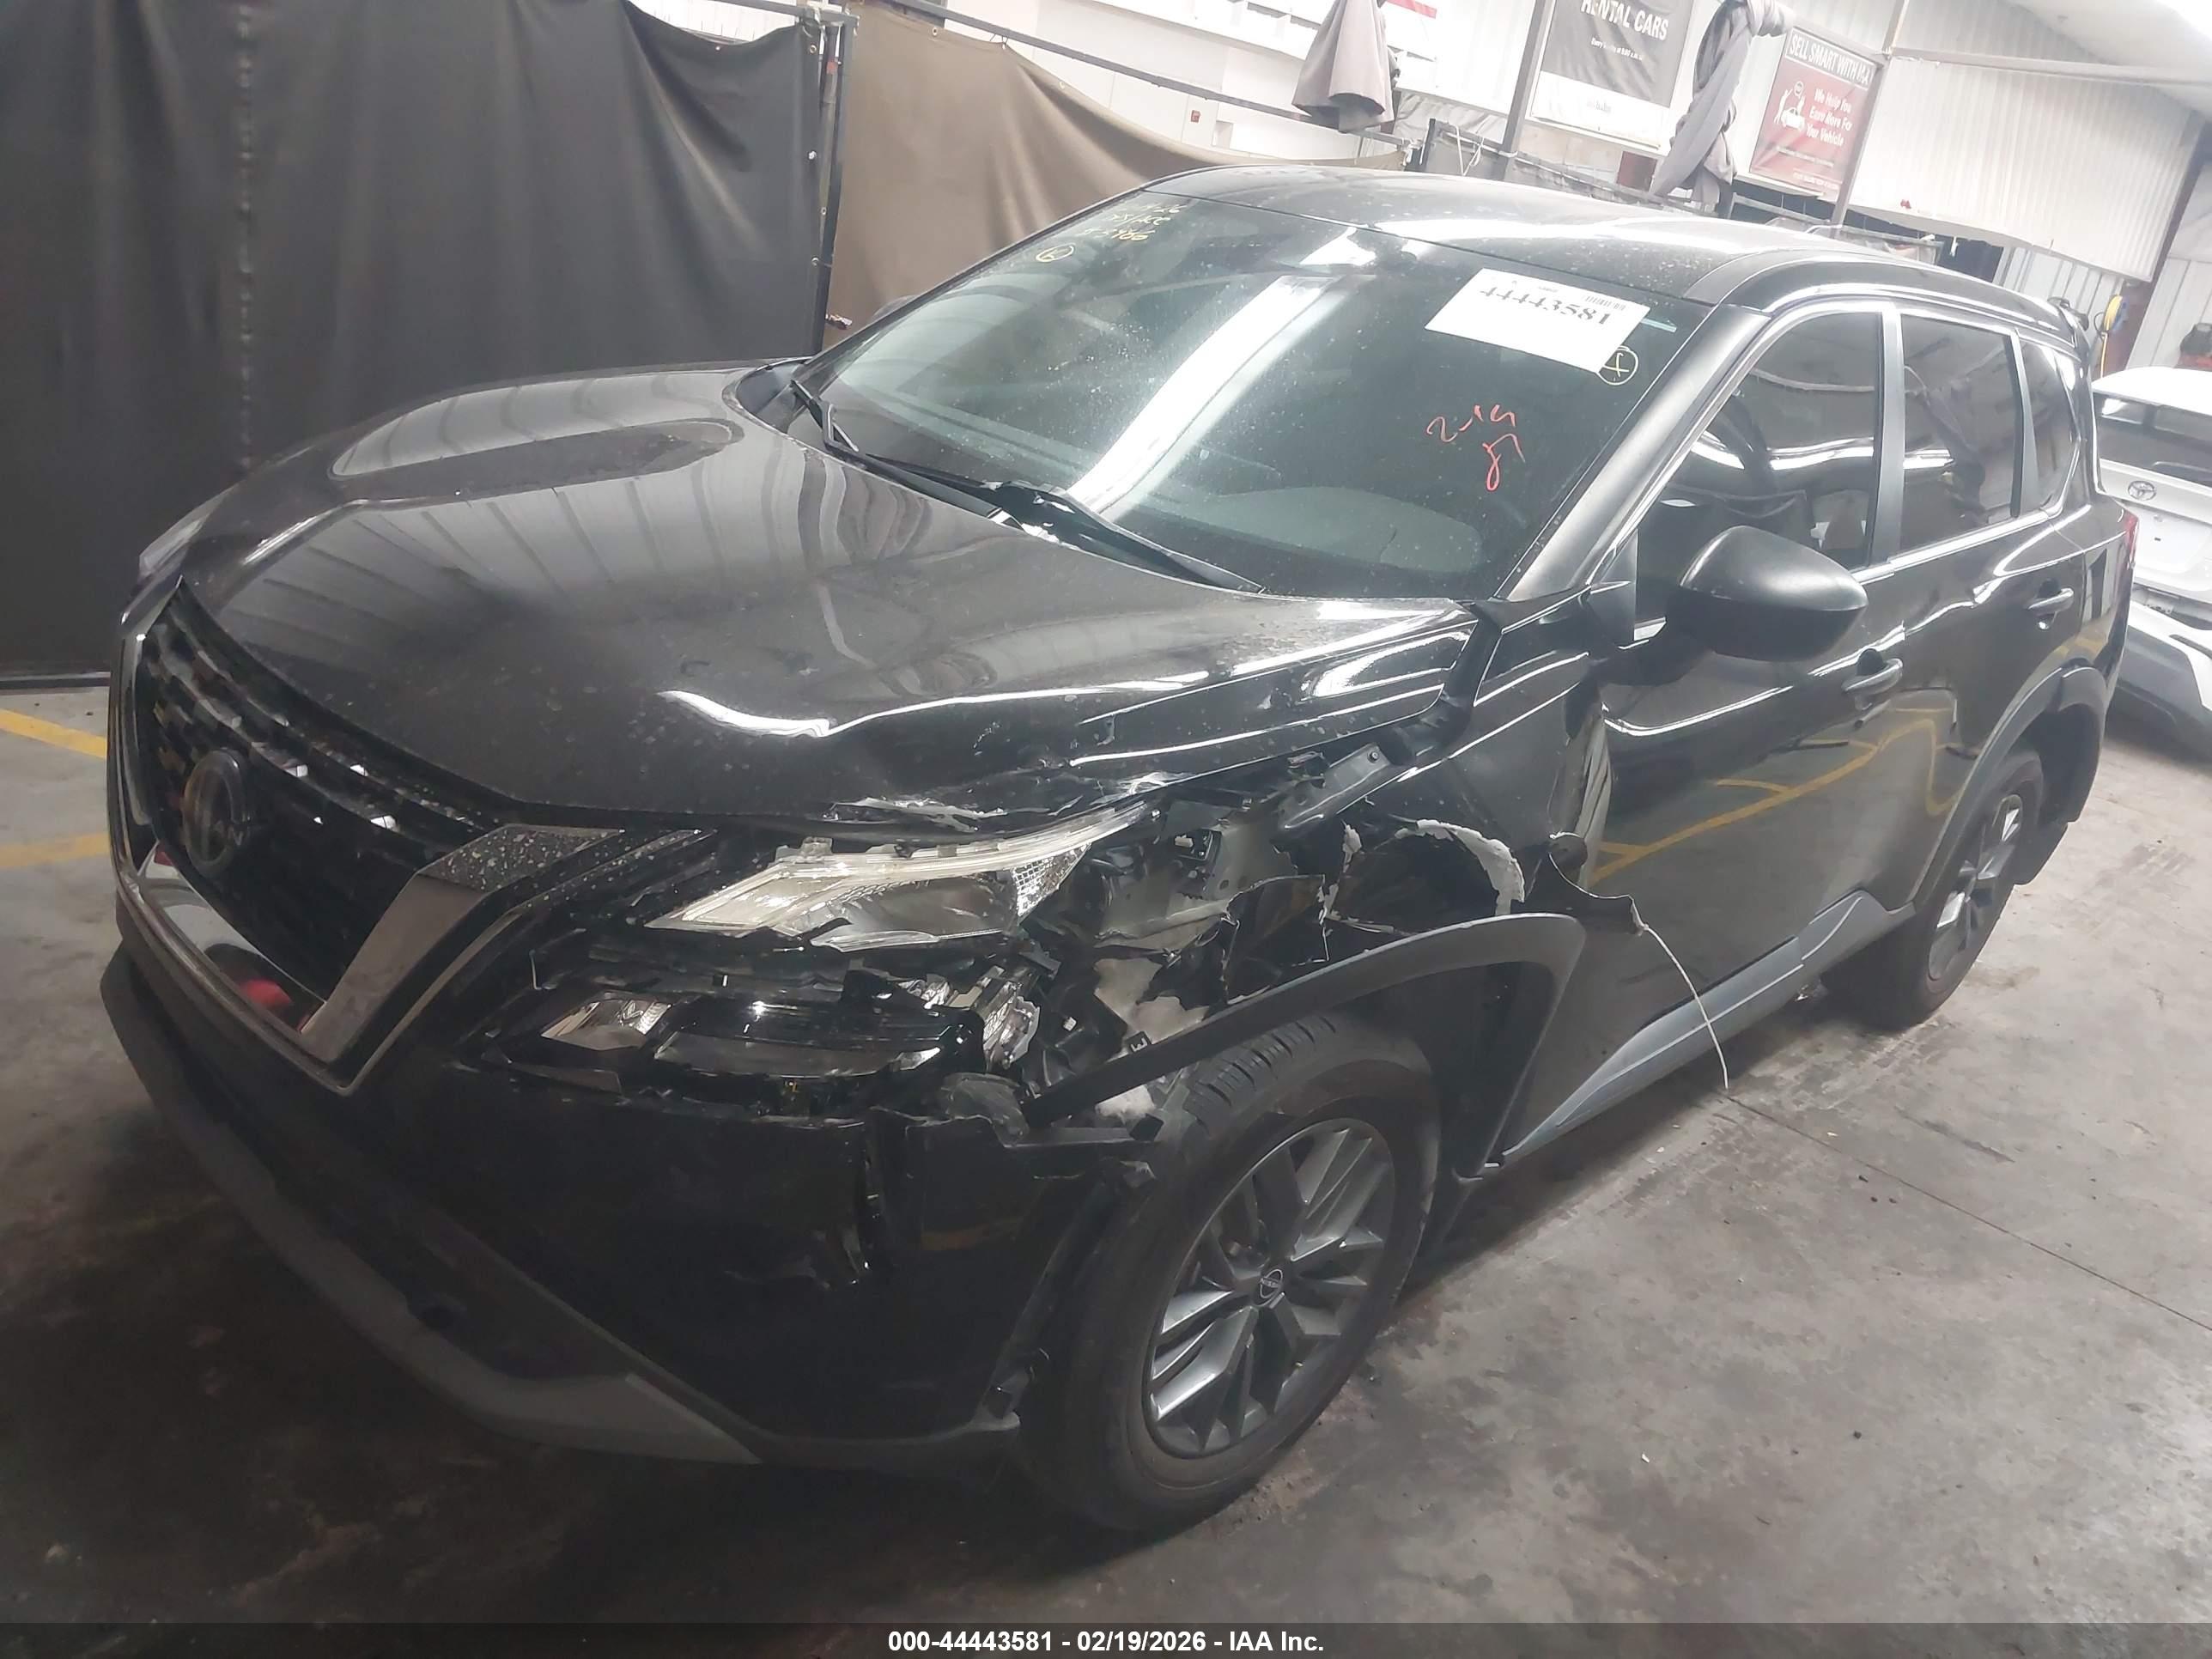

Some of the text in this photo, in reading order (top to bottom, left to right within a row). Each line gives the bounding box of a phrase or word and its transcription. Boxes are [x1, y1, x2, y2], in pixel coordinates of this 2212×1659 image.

[1634, 10, 1668, 40] CARS
[1790, 34, 1808, 59] SELL
[1808, 44, 1838, 71] SMART
[1838, 53, 1859, 79] WITH
[1820, 128, 1844, 146] Vehicle
[1479, 287, 1612, 325] 44443581
